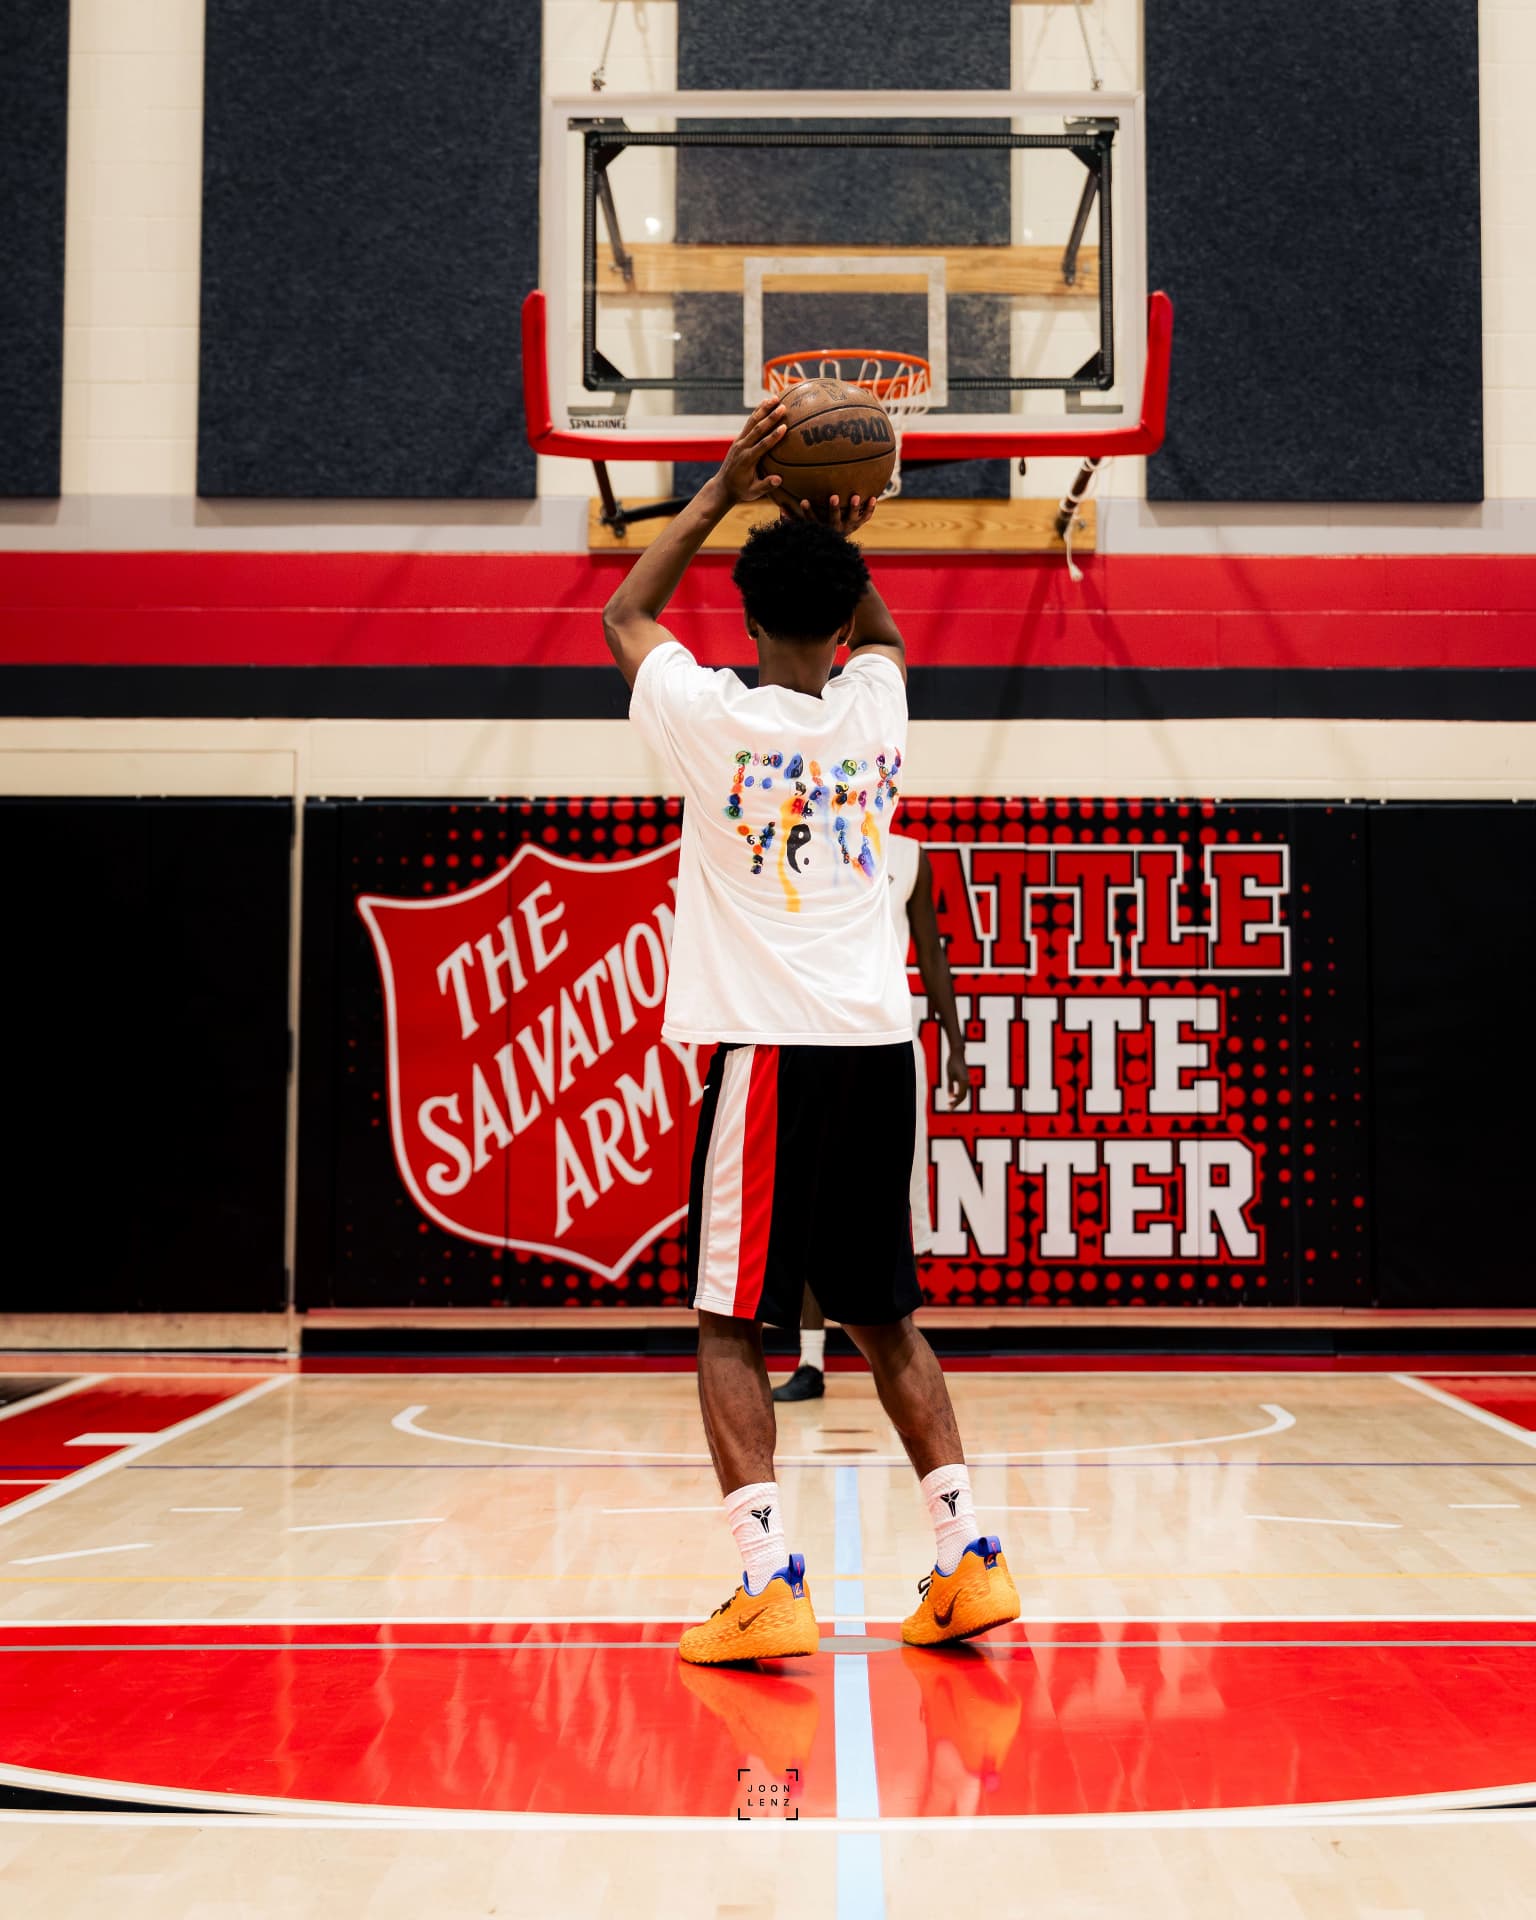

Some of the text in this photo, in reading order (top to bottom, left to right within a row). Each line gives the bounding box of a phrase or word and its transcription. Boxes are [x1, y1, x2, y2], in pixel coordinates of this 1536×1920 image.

[569, 418, 627, 430] SPALDING
[800, 416, 891, 446] Wilson
[436, 881, 569, 1040] THE
[911, 996, 1220, 1114] HITE
[554, 1037, 704, 1238] ARMY
